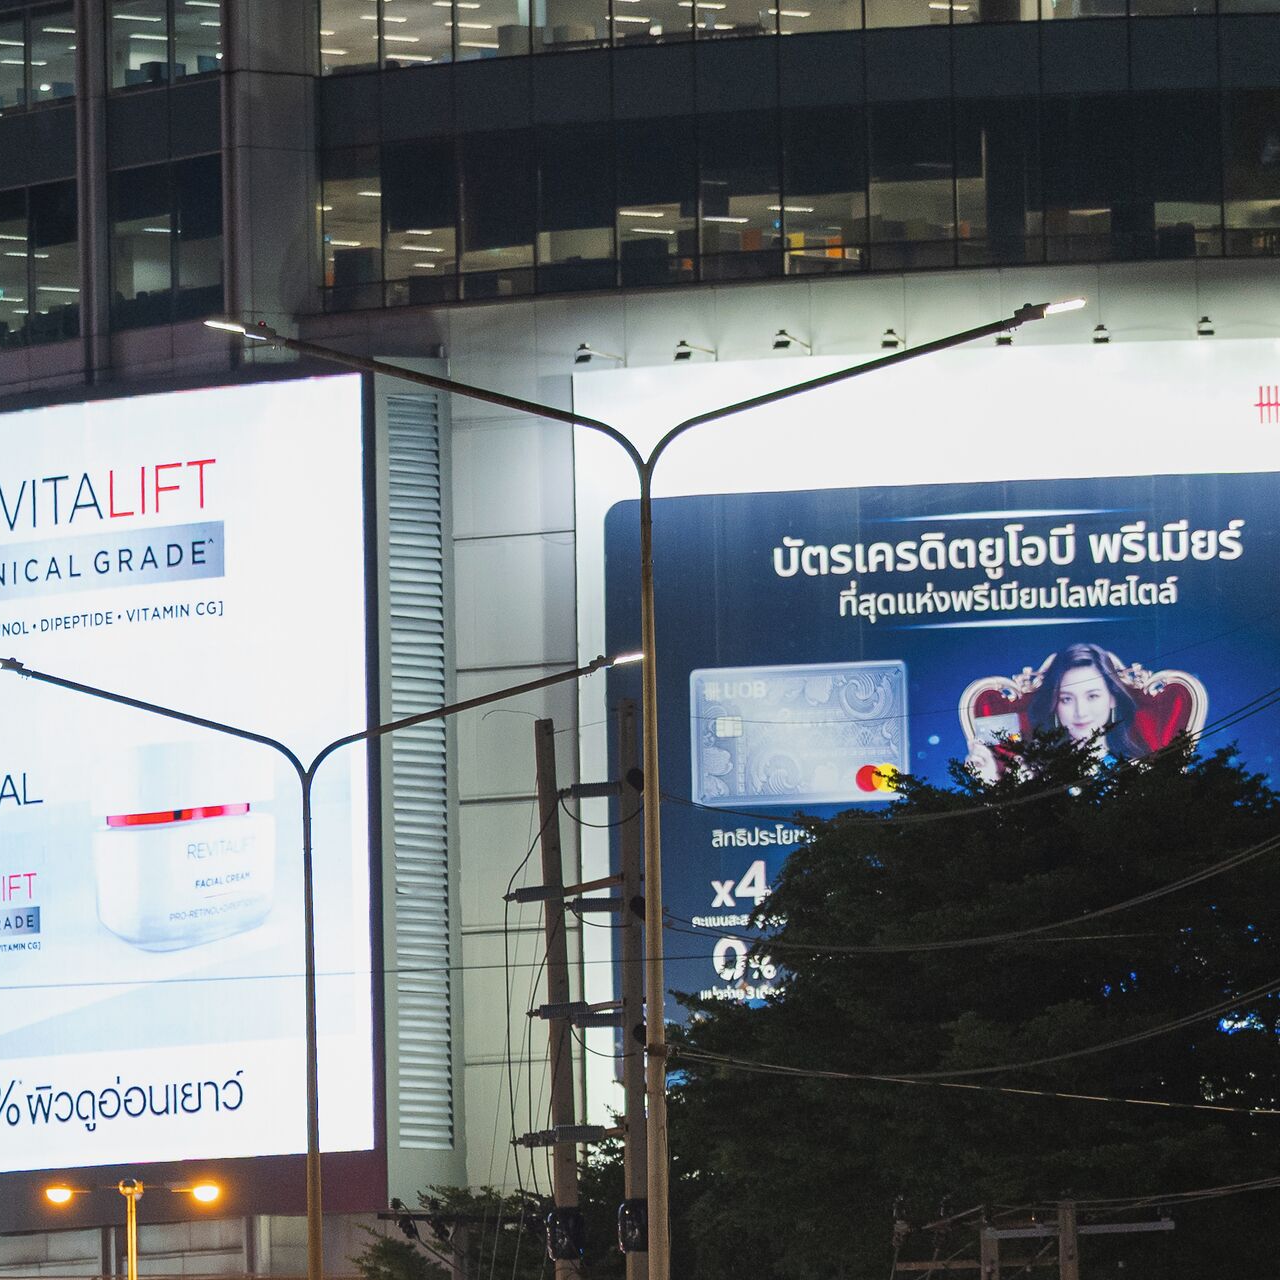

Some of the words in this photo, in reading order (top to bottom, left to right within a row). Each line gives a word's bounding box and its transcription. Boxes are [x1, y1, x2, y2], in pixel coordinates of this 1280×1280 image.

[772, 523, 1076, 580] บัตรเครดิตยูโอบี
[1087, 519, 1246, 567] พรีเมียร์
[40, 611, 114, 633] DIPEPTIDE
[125, 603, 191, 624] VITAMIN
[839, 575, 1179, 625] ที่สุดแห่งพรีเมียมไลฟ์สไตล์
[195, 877, 224, 889] FACIAL
[26, 1070, 245, 1132] ผิวดูอ่อนเยาว์
